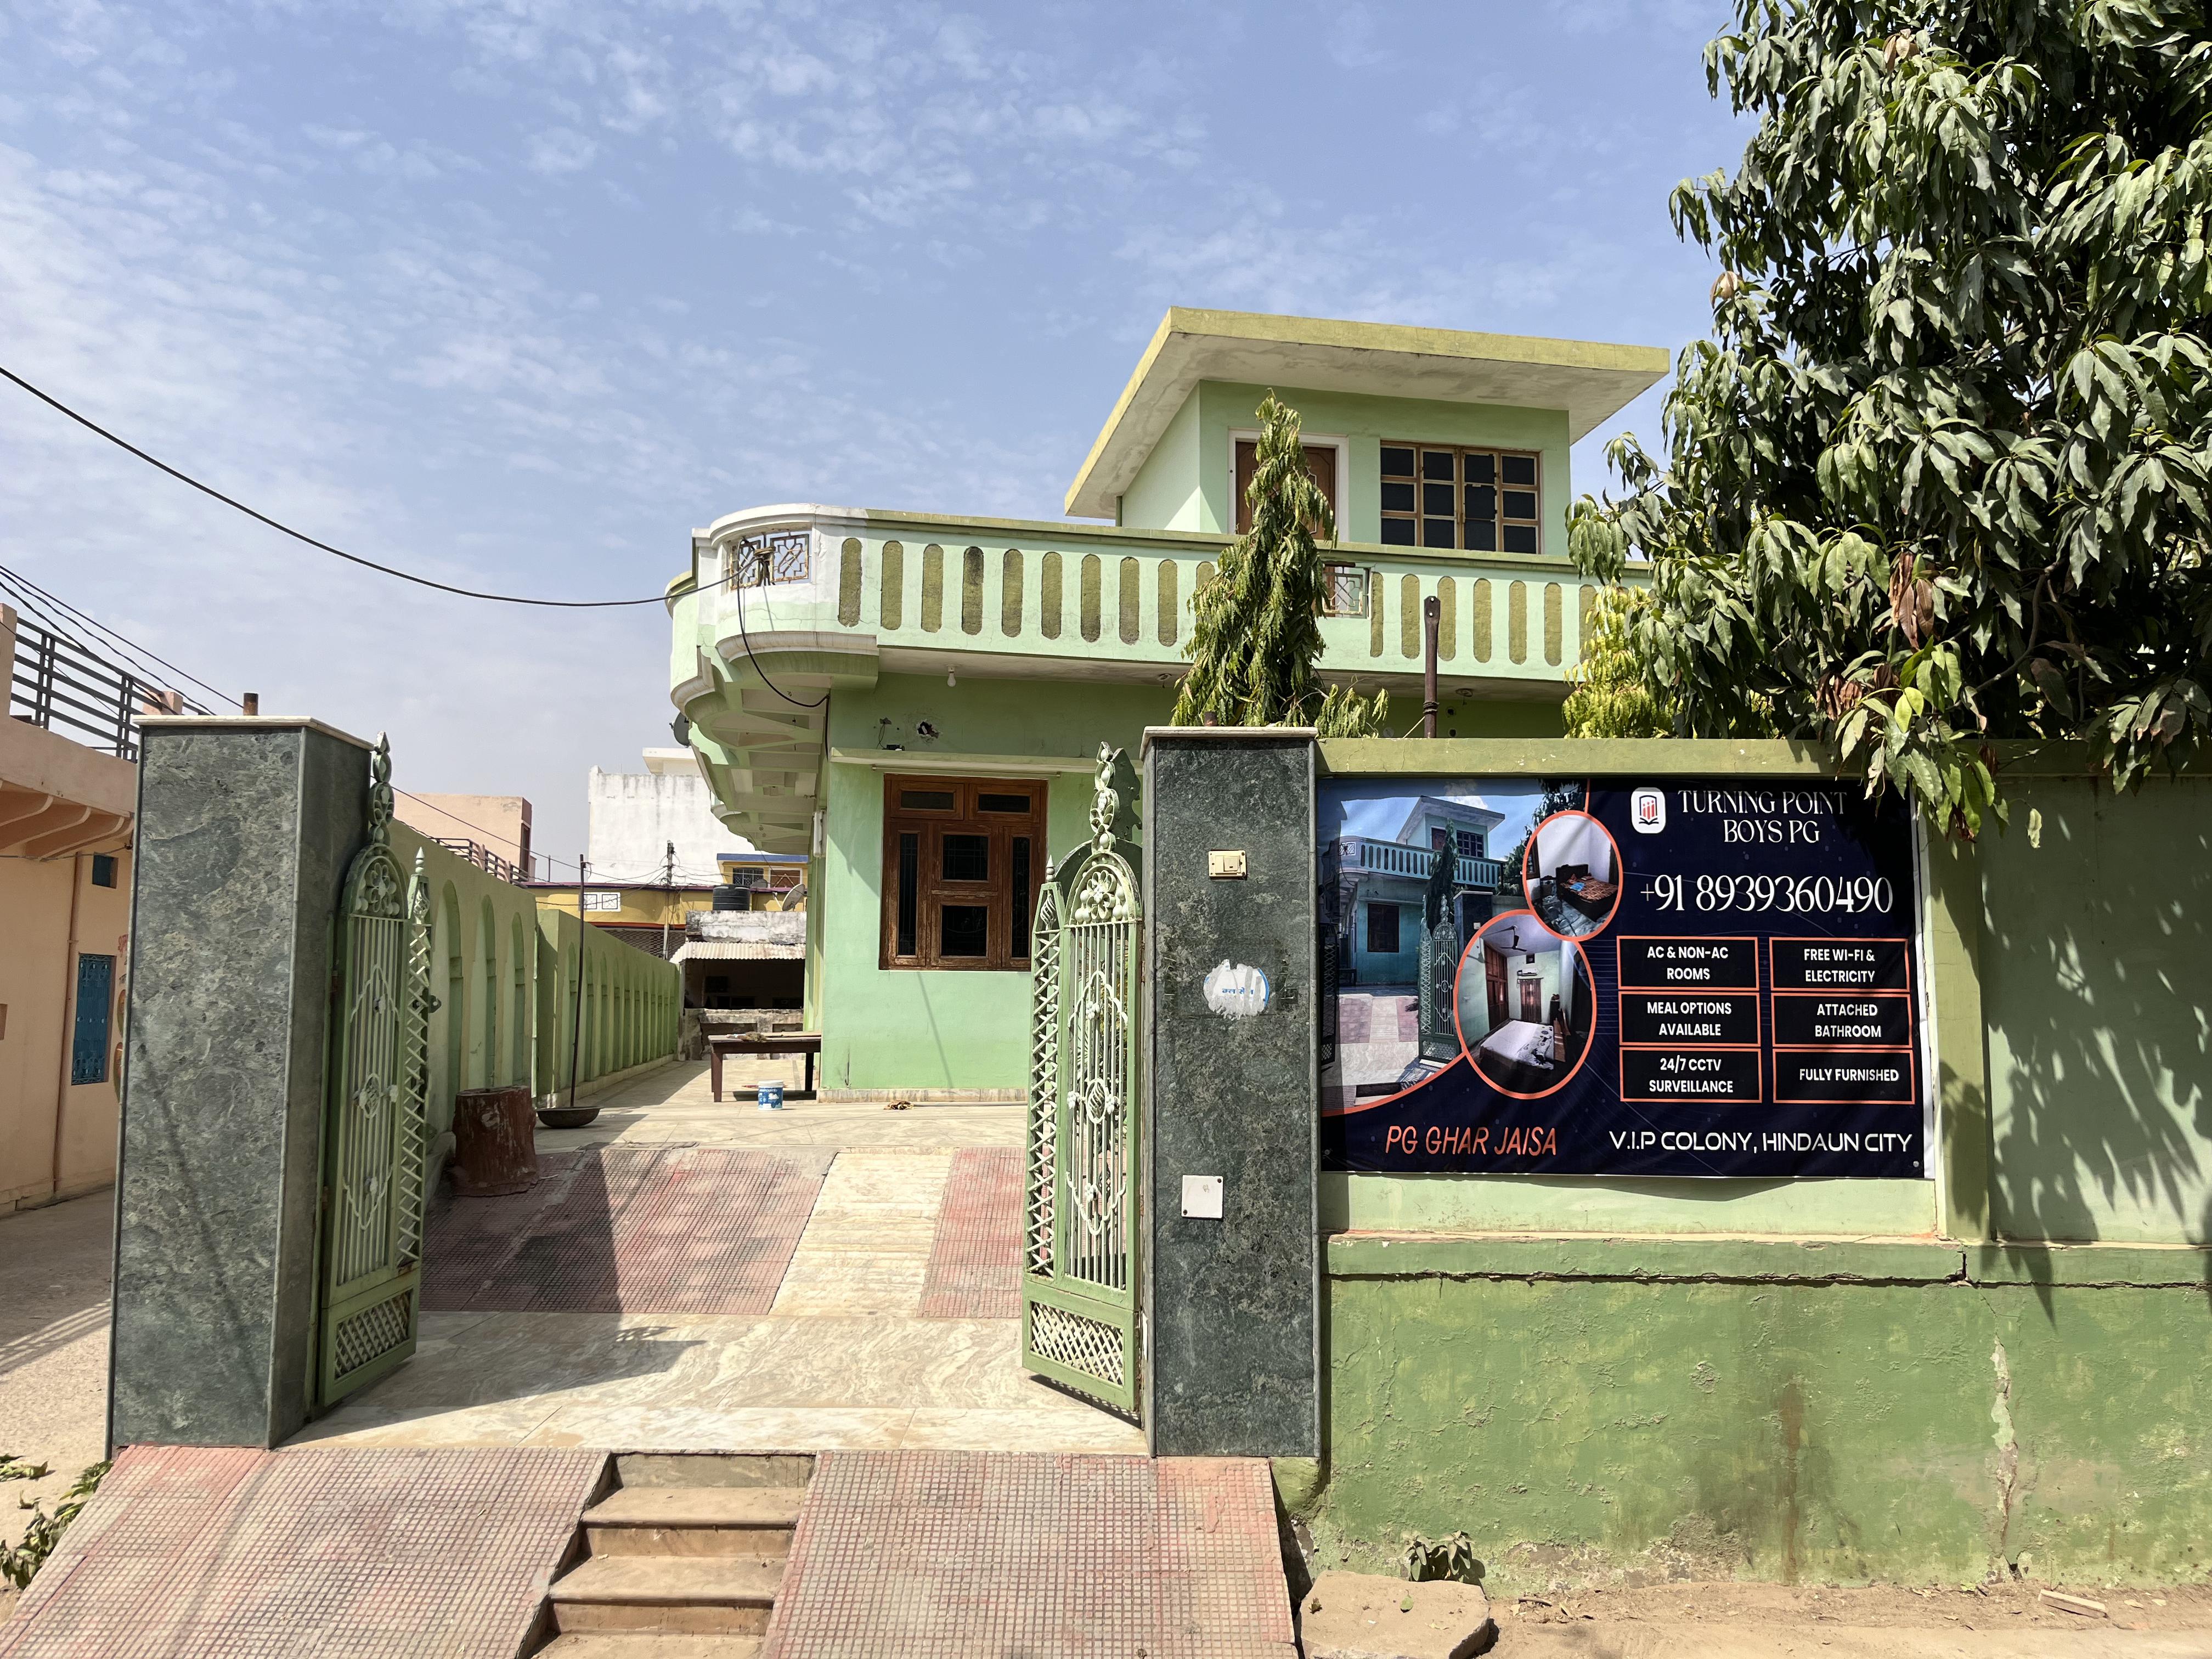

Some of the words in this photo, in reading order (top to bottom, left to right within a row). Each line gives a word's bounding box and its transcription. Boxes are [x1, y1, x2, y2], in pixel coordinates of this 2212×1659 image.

[1678, 790, 1775, 813] TURNING
[1782, 791, 1847, 814] POINT
[1724, 820, 1782, 842] BOYS
[1789, 820, 1819, 843] PG
[1640, 874, 1685, 911] +91
[1696, 874, 1893, 913] 8939360490
[1647, 946, 1664, 958] AC
[1667, 946, 1675, 958] &
[1679, 947, 1728, 958] NON-AC
[1804, 949, 1830, 960] FREE
[1832, 949, 1863, 961] WI-FI
[1866, 950, 1875, 961] &
[1667, 968, 1709, 979] ROOMS
[1805, 970, 1875, 982] ELECTRICITY
[1647, 1002, 1678, 1013] MEAL
[1680, 1002, 1731, 1014] OPTIONS
[1817, 1004, 1877, 1015] ATTACHED
[1659, 1024, 1721, 1035] AVAILABLE
[1815, 1025, 1881, 1037] BATHROOM
[1661, 1055, 1686, 1073] 24/7
[1689, 1059, 1721, 1070] CCTV
[1800, 1069, 1832, 1080] FULLY
[1835, 1069, 1899, 1081] FURNISHED
[1650, 1080, 1733, 1092] SURVEILLANCE
[1386, 1126, 1418, 1154] PG
[1426, 1126, 1488, 1154] GHAR
[1494, 1127, 1556, 1155] JAISA
[1609, 1131, 1655, 1149] V.I.P
[1661, 1132, 1757, 1153] COLONY,
[1763, 1133, 1858, 1151] HINDAUN
[1865, 1133, 1912, 1152] CITY
